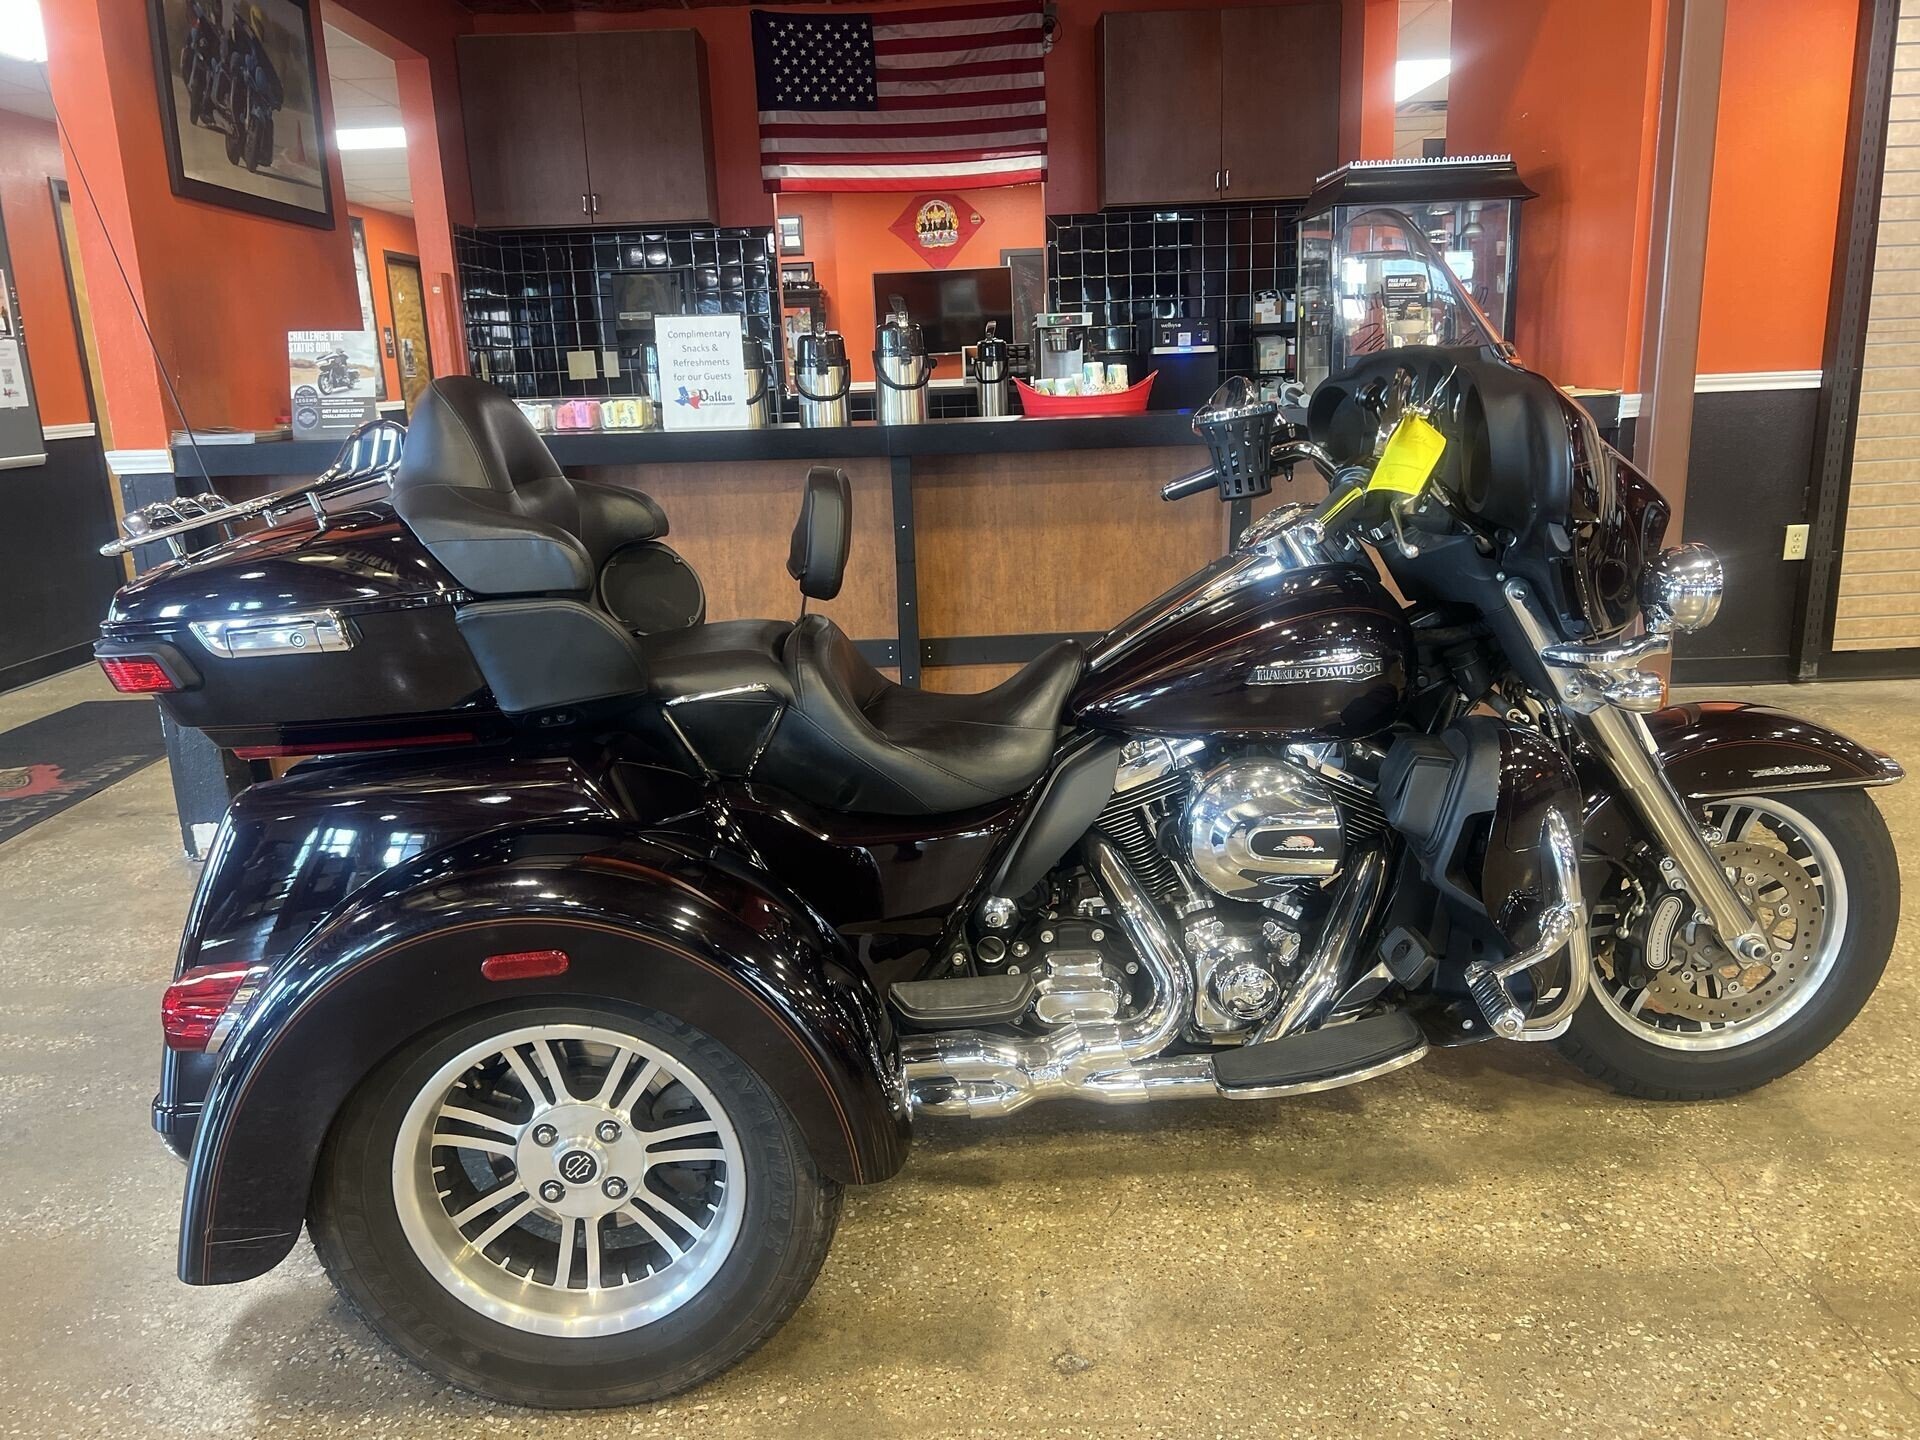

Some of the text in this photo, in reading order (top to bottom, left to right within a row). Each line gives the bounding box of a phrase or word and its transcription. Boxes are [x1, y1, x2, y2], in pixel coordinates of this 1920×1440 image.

[918, 229, 958, 243] TEXAS
[288, 332, 344, 341] CHALLENGE THE
[667, 330, 731, 339] Complimentary
[288, 342, 315, 353] STATUS
[682, 343, 719, 353] Snacks &
[673, 358, 730, 367] Refreshments
[673, 373, 685, 381] for
[704, 372, 732, 381] Guests
[697, 389, 733, 402] Dallas
[1256, 662, 1381, 681] HARLEY-DAVIDSON
